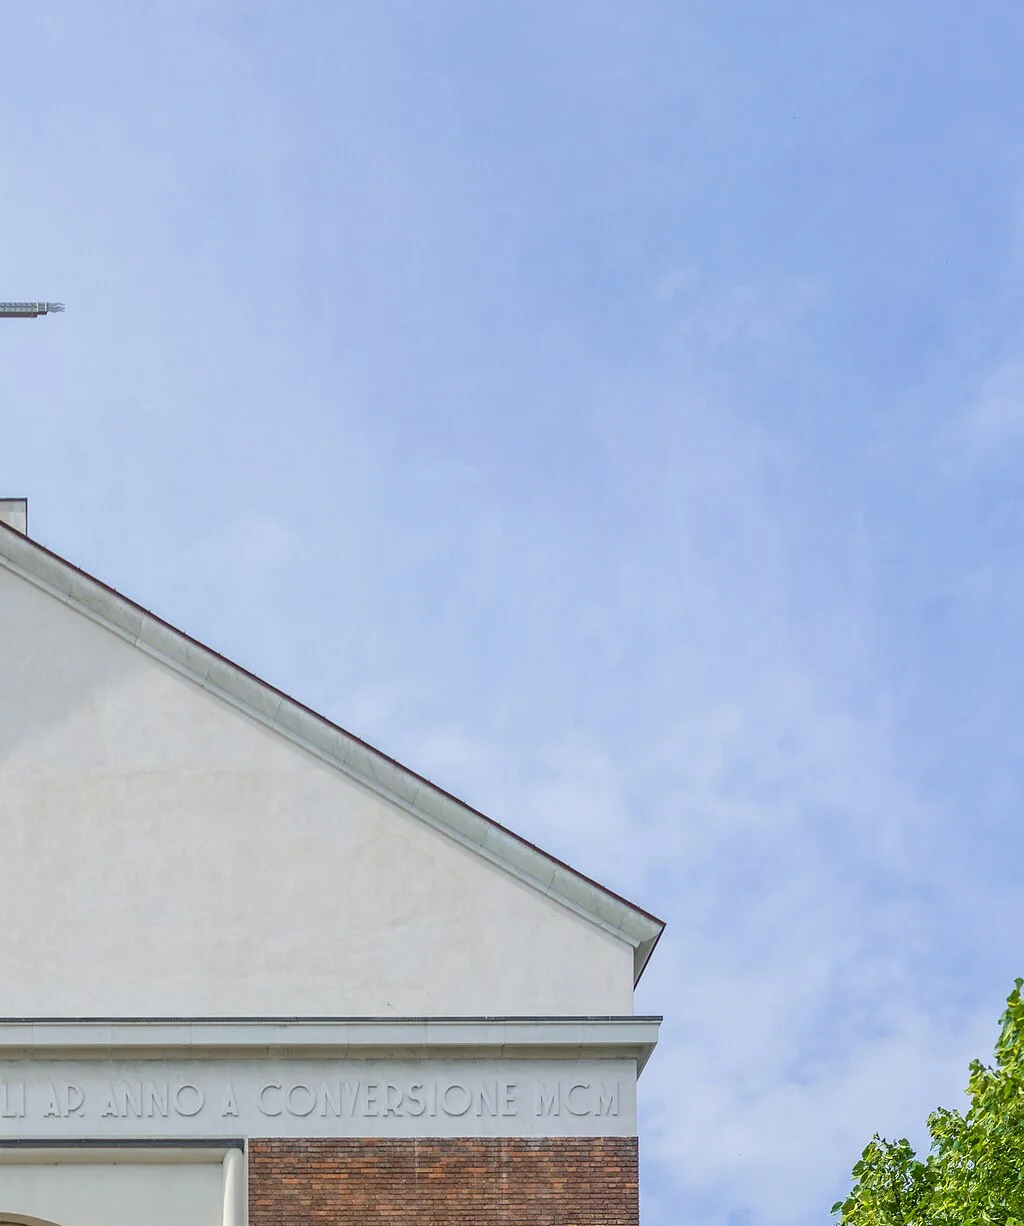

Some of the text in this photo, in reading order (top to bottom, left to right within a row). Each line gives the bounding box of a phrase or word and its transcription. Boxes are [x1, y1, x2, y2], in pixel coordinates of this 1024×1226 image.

[42, 1081, 85, 1118] AP.
[100, 1081, 205, 1118] ANNO
[220, 1081, 239, 1118] A
[255, 1081, 517, 1118] CONVERSIONE
[534, 1081, 620, 1118] MCM
